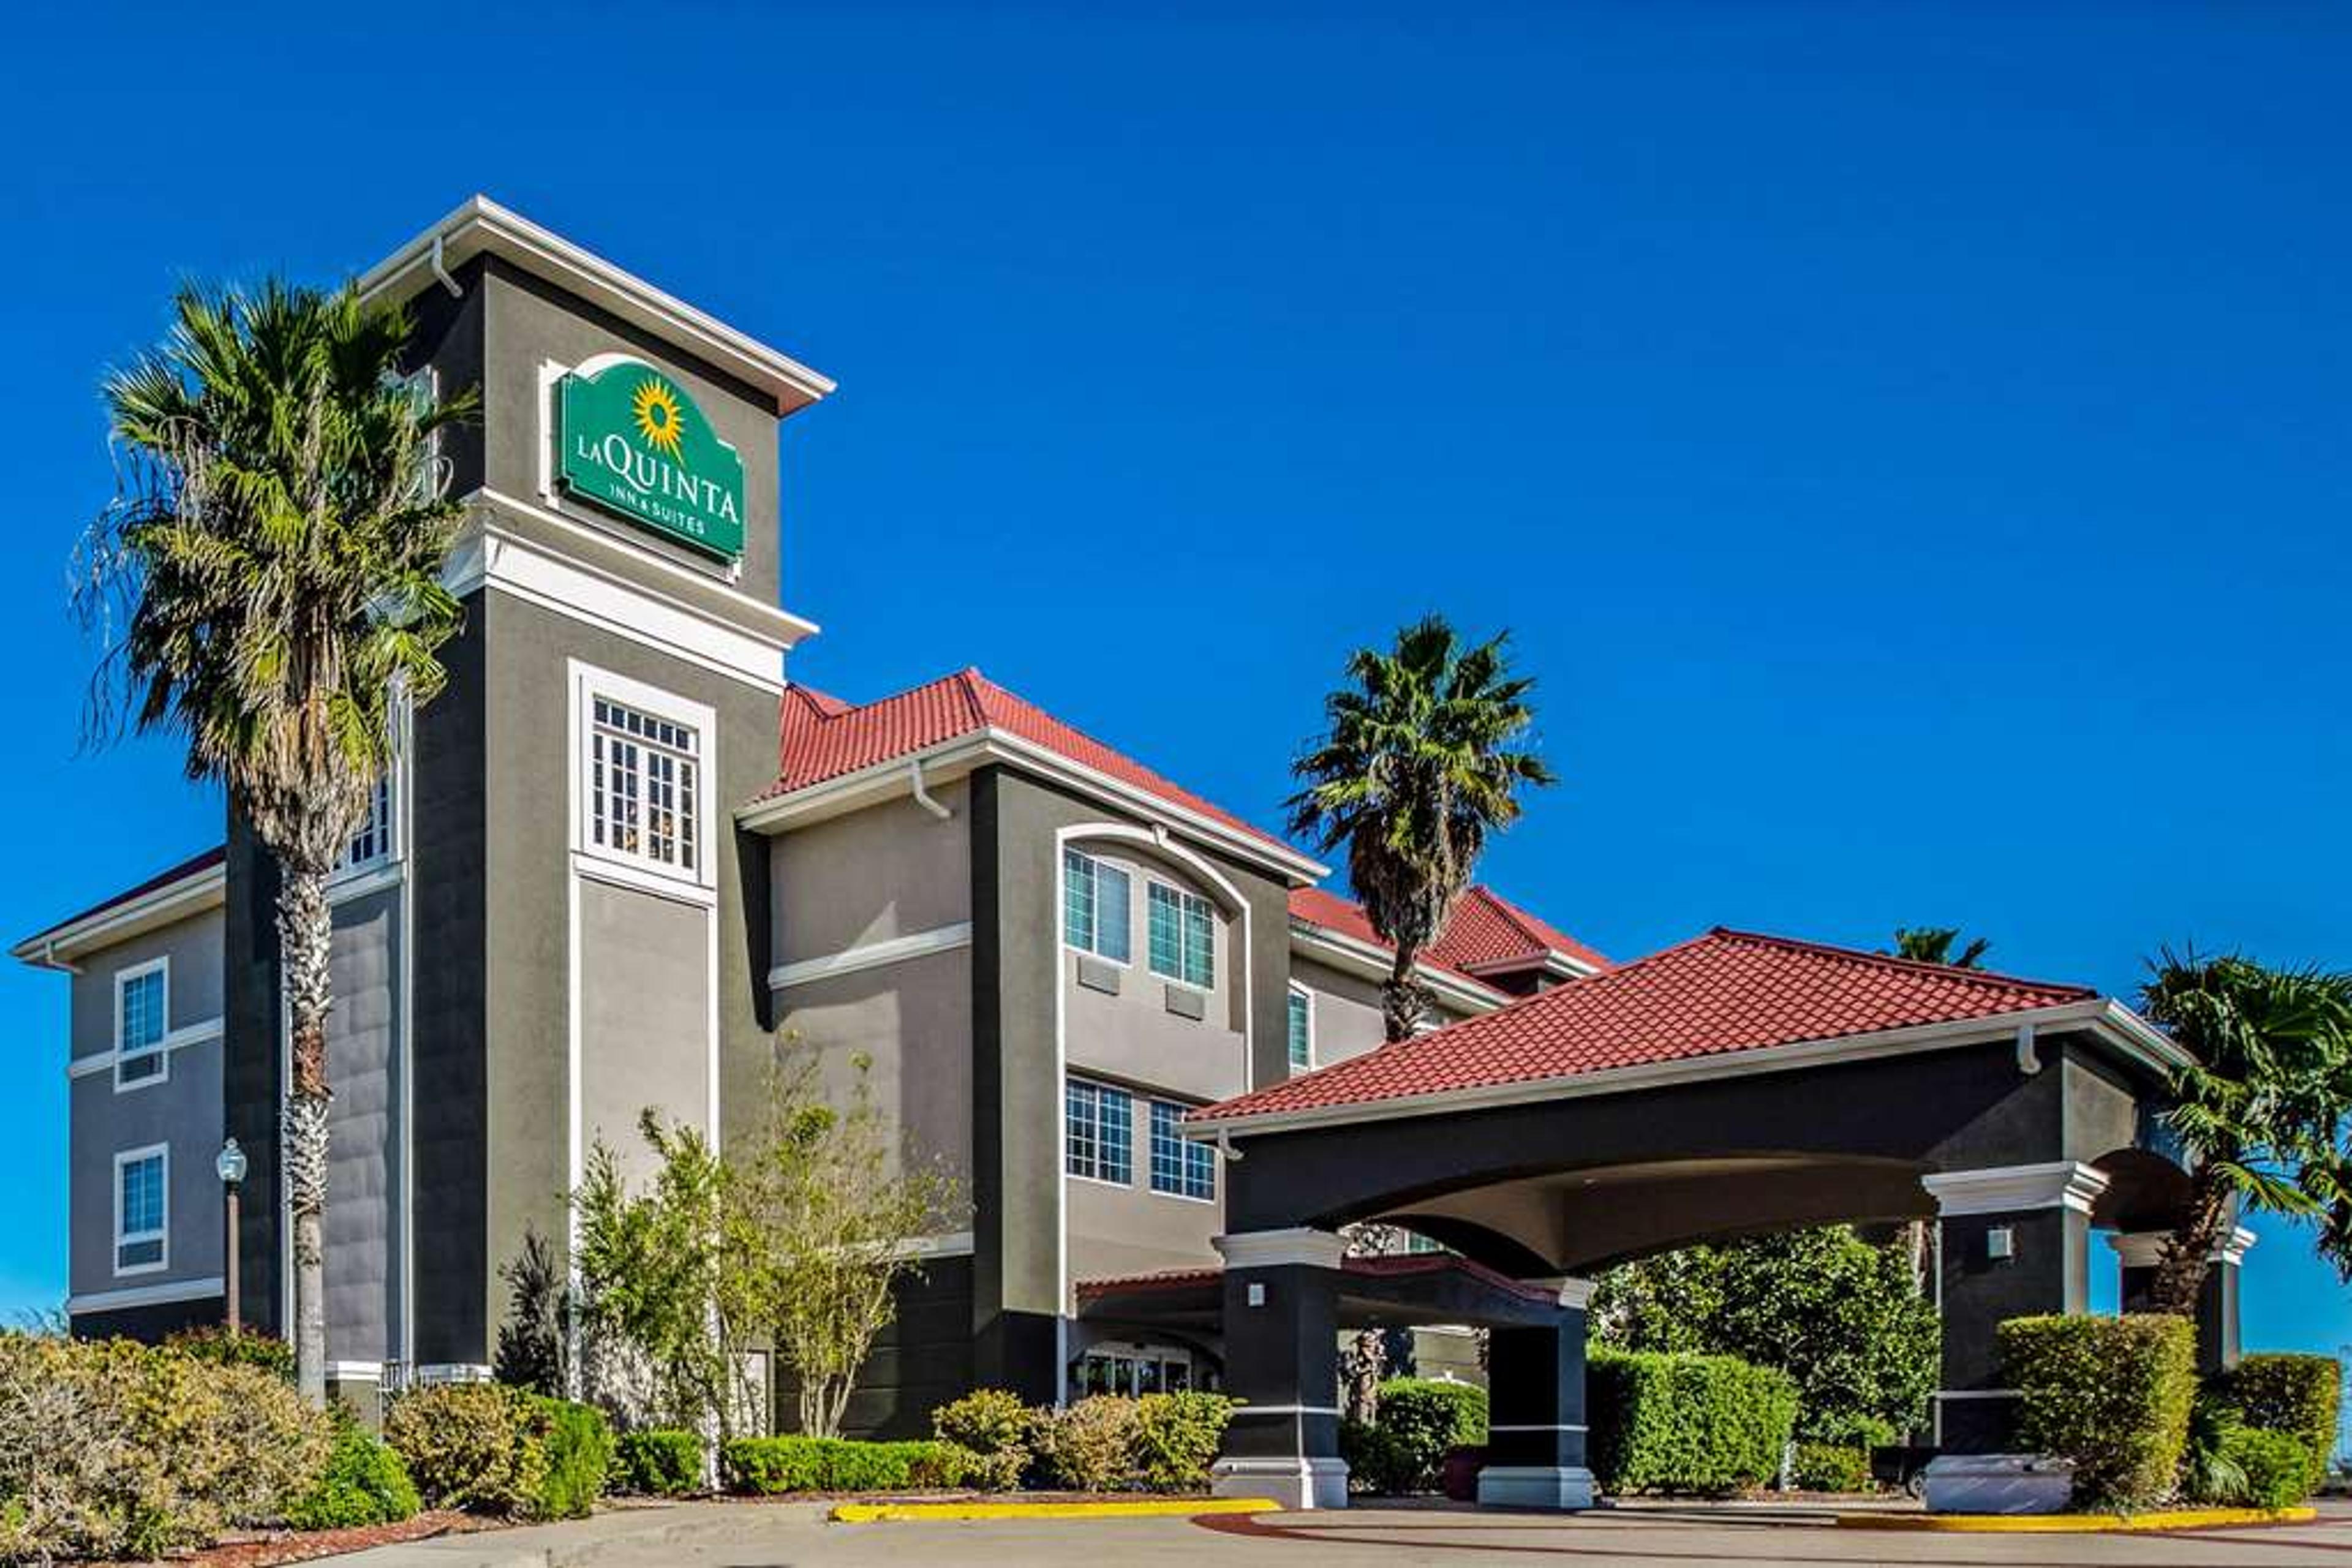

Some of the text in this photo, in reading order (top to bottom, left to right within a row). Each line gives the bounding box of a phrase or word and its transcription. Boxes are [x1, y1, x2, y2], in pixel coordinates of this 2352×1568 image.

[578, 434, 739, 525] LA QUINTA
[609, 484, 636, 507] INN
[652, 503, 705, 535] SUITES
